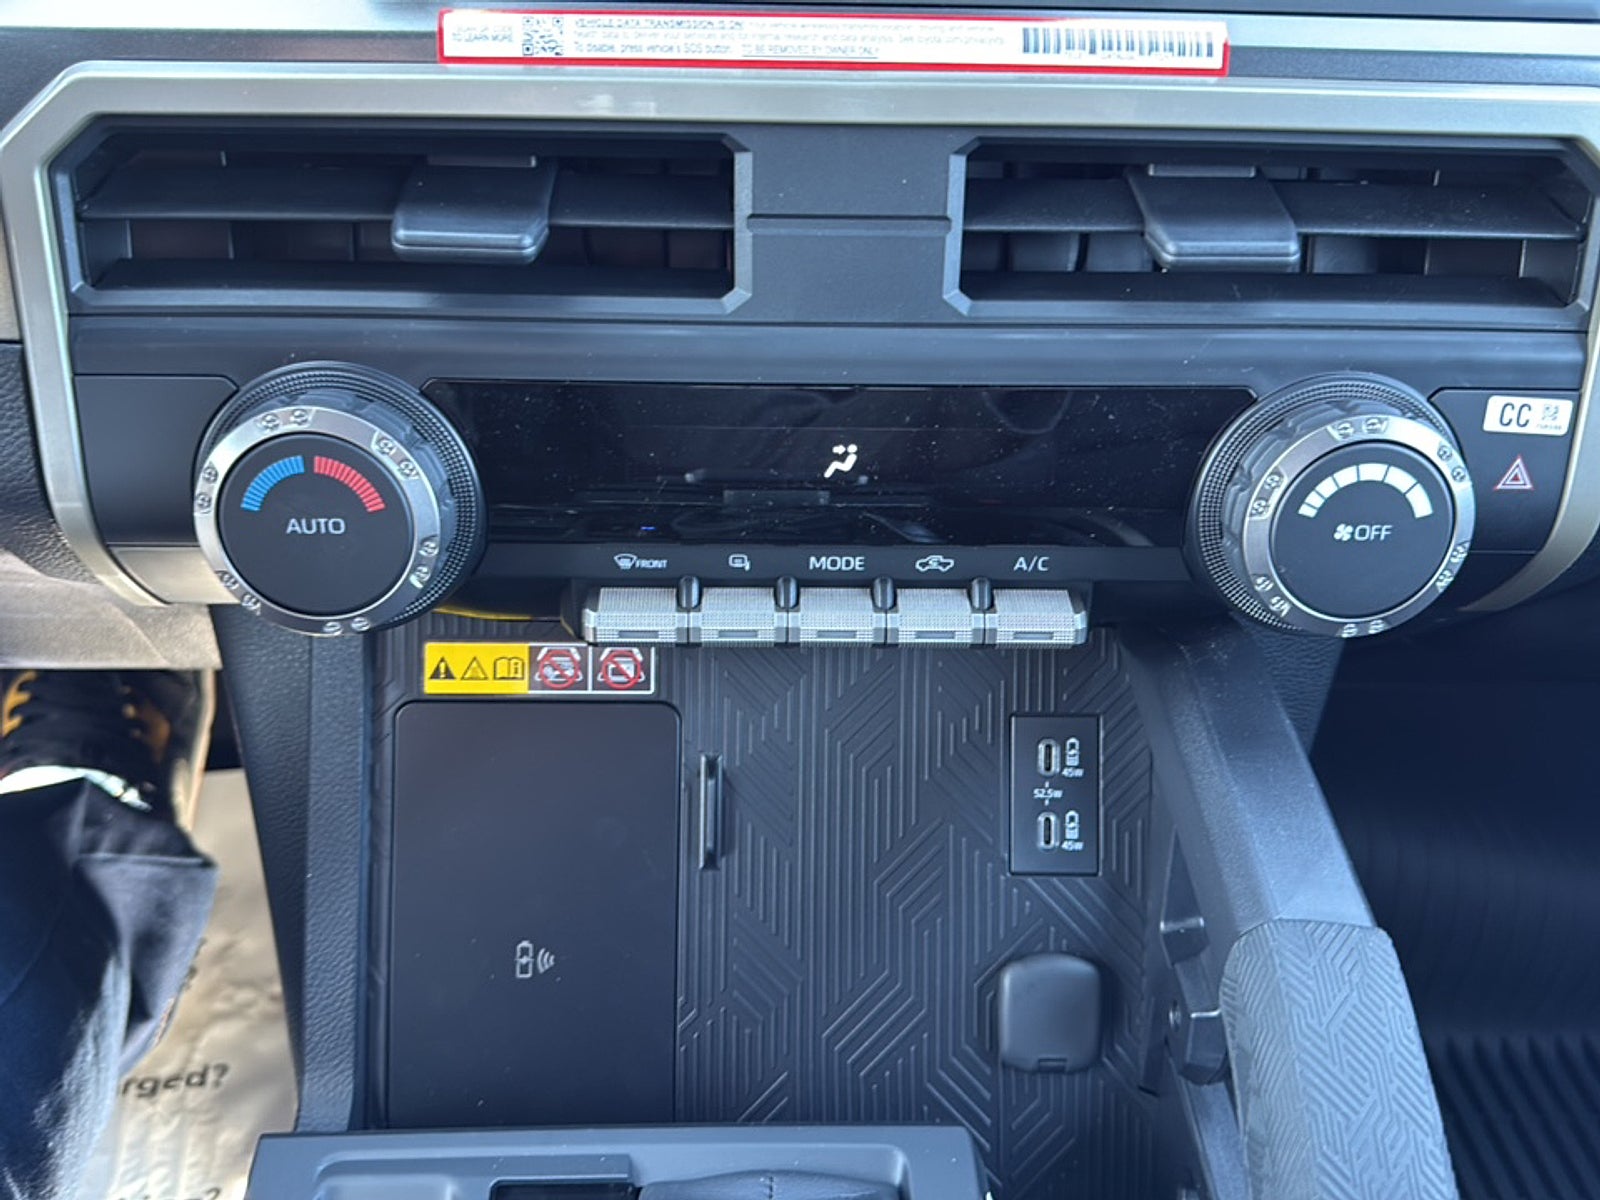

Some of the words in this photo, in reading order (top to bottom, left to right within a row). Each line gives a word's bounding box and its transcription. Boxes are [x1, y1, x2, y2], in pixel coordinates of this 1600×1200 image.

[1499, 402, 1532, 428] CC
[286, 517, 346, 535] AUTO
[1354, 524, 1393, 541] OFF
[635, 559, 668, 569] FRONT
[809, 556, 865, 571] MODE
[1013, 556, 1050, 571] A/C
[1062, 767, 1085, 778] 45W
[1033, 788, 1063, 798] 52.5W
[1061, 840, 1084, 851] 45W
